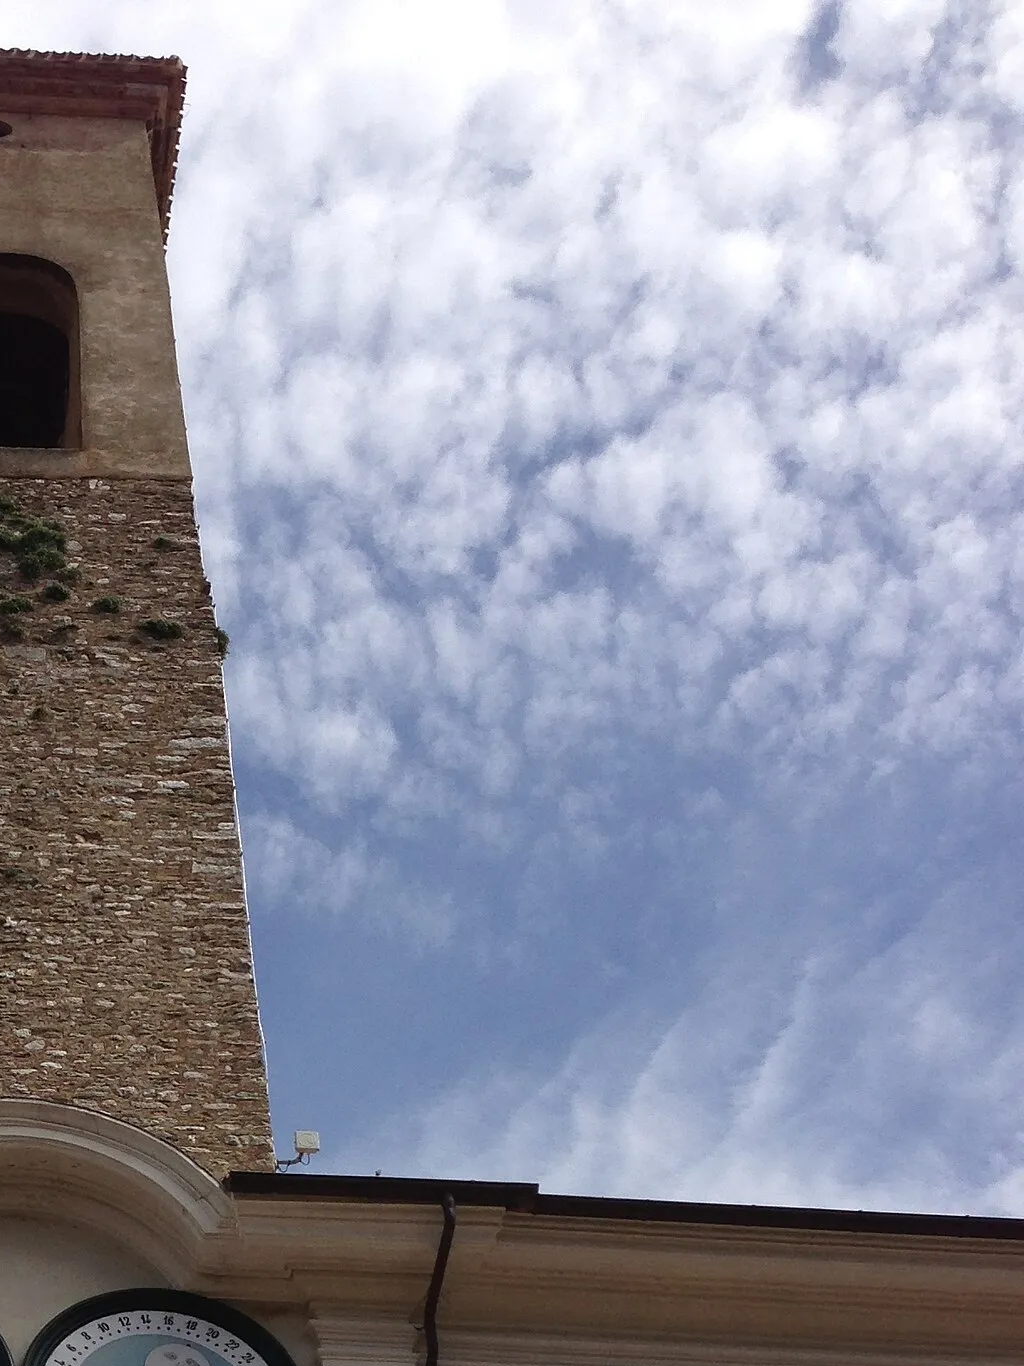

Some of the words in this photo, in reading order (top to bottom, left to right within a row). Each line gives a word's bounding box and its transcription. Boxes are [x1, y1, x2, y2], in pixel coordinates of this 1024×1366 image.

[118, 1316, 131, 1327] 12
[140, 1314, 152, 1325] 14
[163, 1315, 175, 1326] 16
[98, 1322, 110, 1333] 10
[185, 1320, 198, 1331] 18
[81, 1331, 92, 1341] 8
[206, 1327, 220, 1339] 20
[67, 1343, 77, 1353] 6
[226, 1339, 240, 1351] 22
[57, 1359, 66, 1366] 4
[241, 1352, 255, 1364] 24
